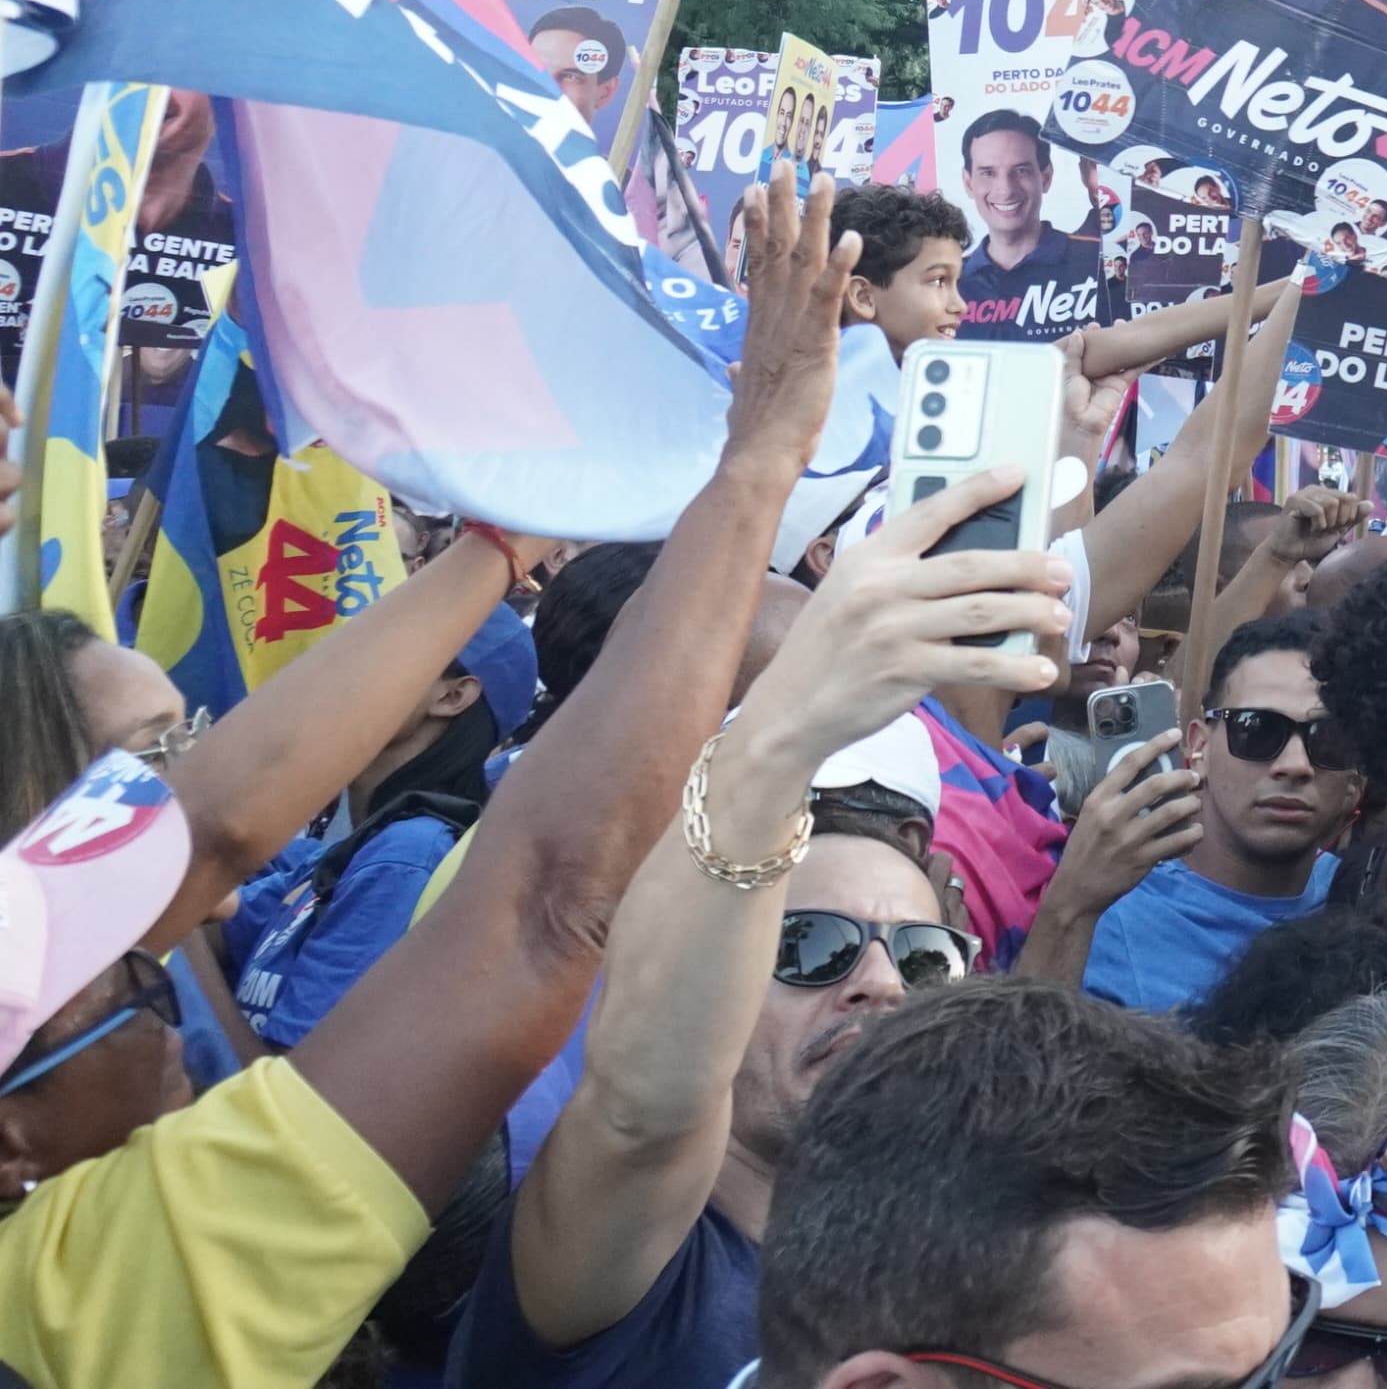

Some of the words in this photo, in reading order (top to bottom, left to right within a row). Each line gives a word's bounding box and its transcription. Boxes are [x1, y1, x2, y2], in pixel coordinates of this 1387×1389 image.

[575, 52, 606, 63] 1044
[984, 83, 1007, 95] DO
[1011, 81, 1051, 94] LADO
[993, 68, 1040, 82] PERTO
[1059, 90, 1130, 117] 1044
[688, 110, 767, 174] 10
[1153, 237, 1192, 255] DO
[697, 298, 741, 330] ZÉ
[1315, 350, 1367, 383] DO
[334, 510, 385, 618] Neto
[255, 518, 343, 644] 44
